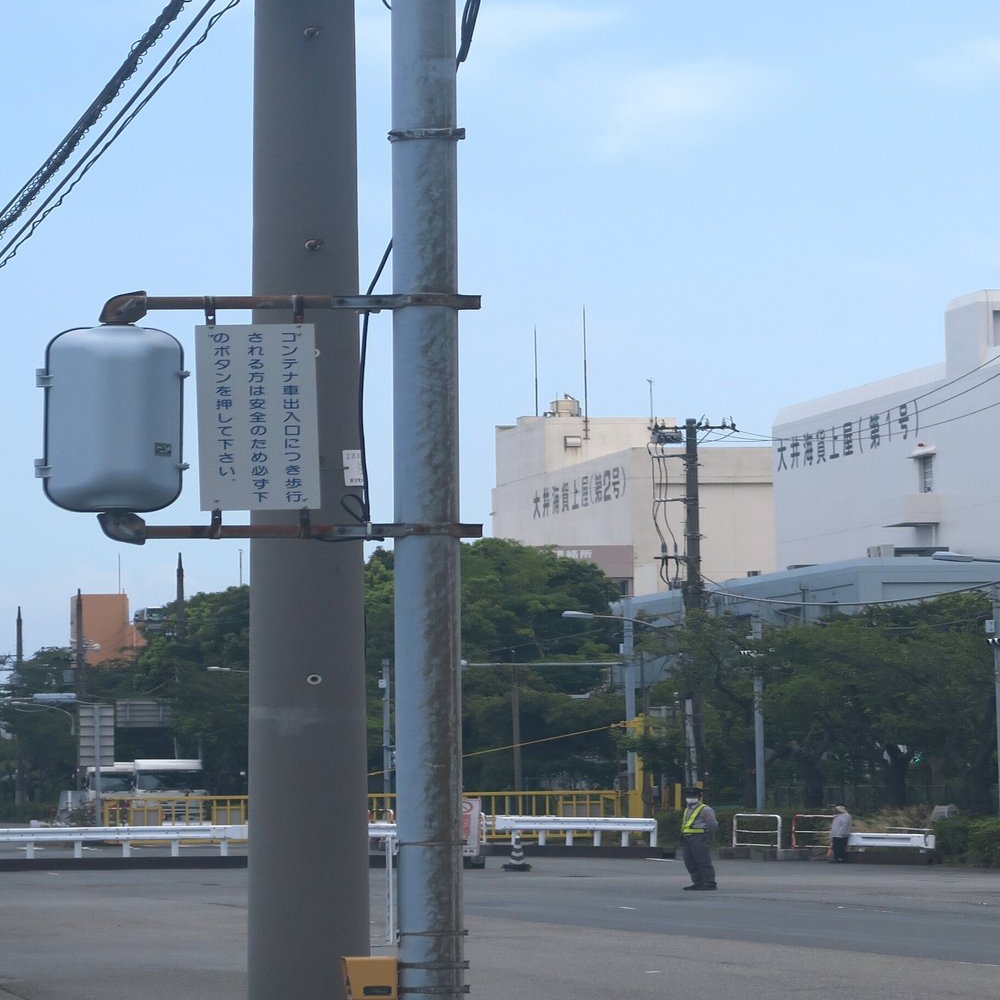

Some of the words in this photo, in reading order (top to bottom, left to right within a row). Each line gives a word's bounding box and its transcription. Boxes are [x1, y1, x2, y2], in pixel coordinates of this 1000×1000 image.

[247, 332, 270, 503] される方は安全のため必ず下
[281, 332, 303, 503] コンテナ車出入口につき歩行
